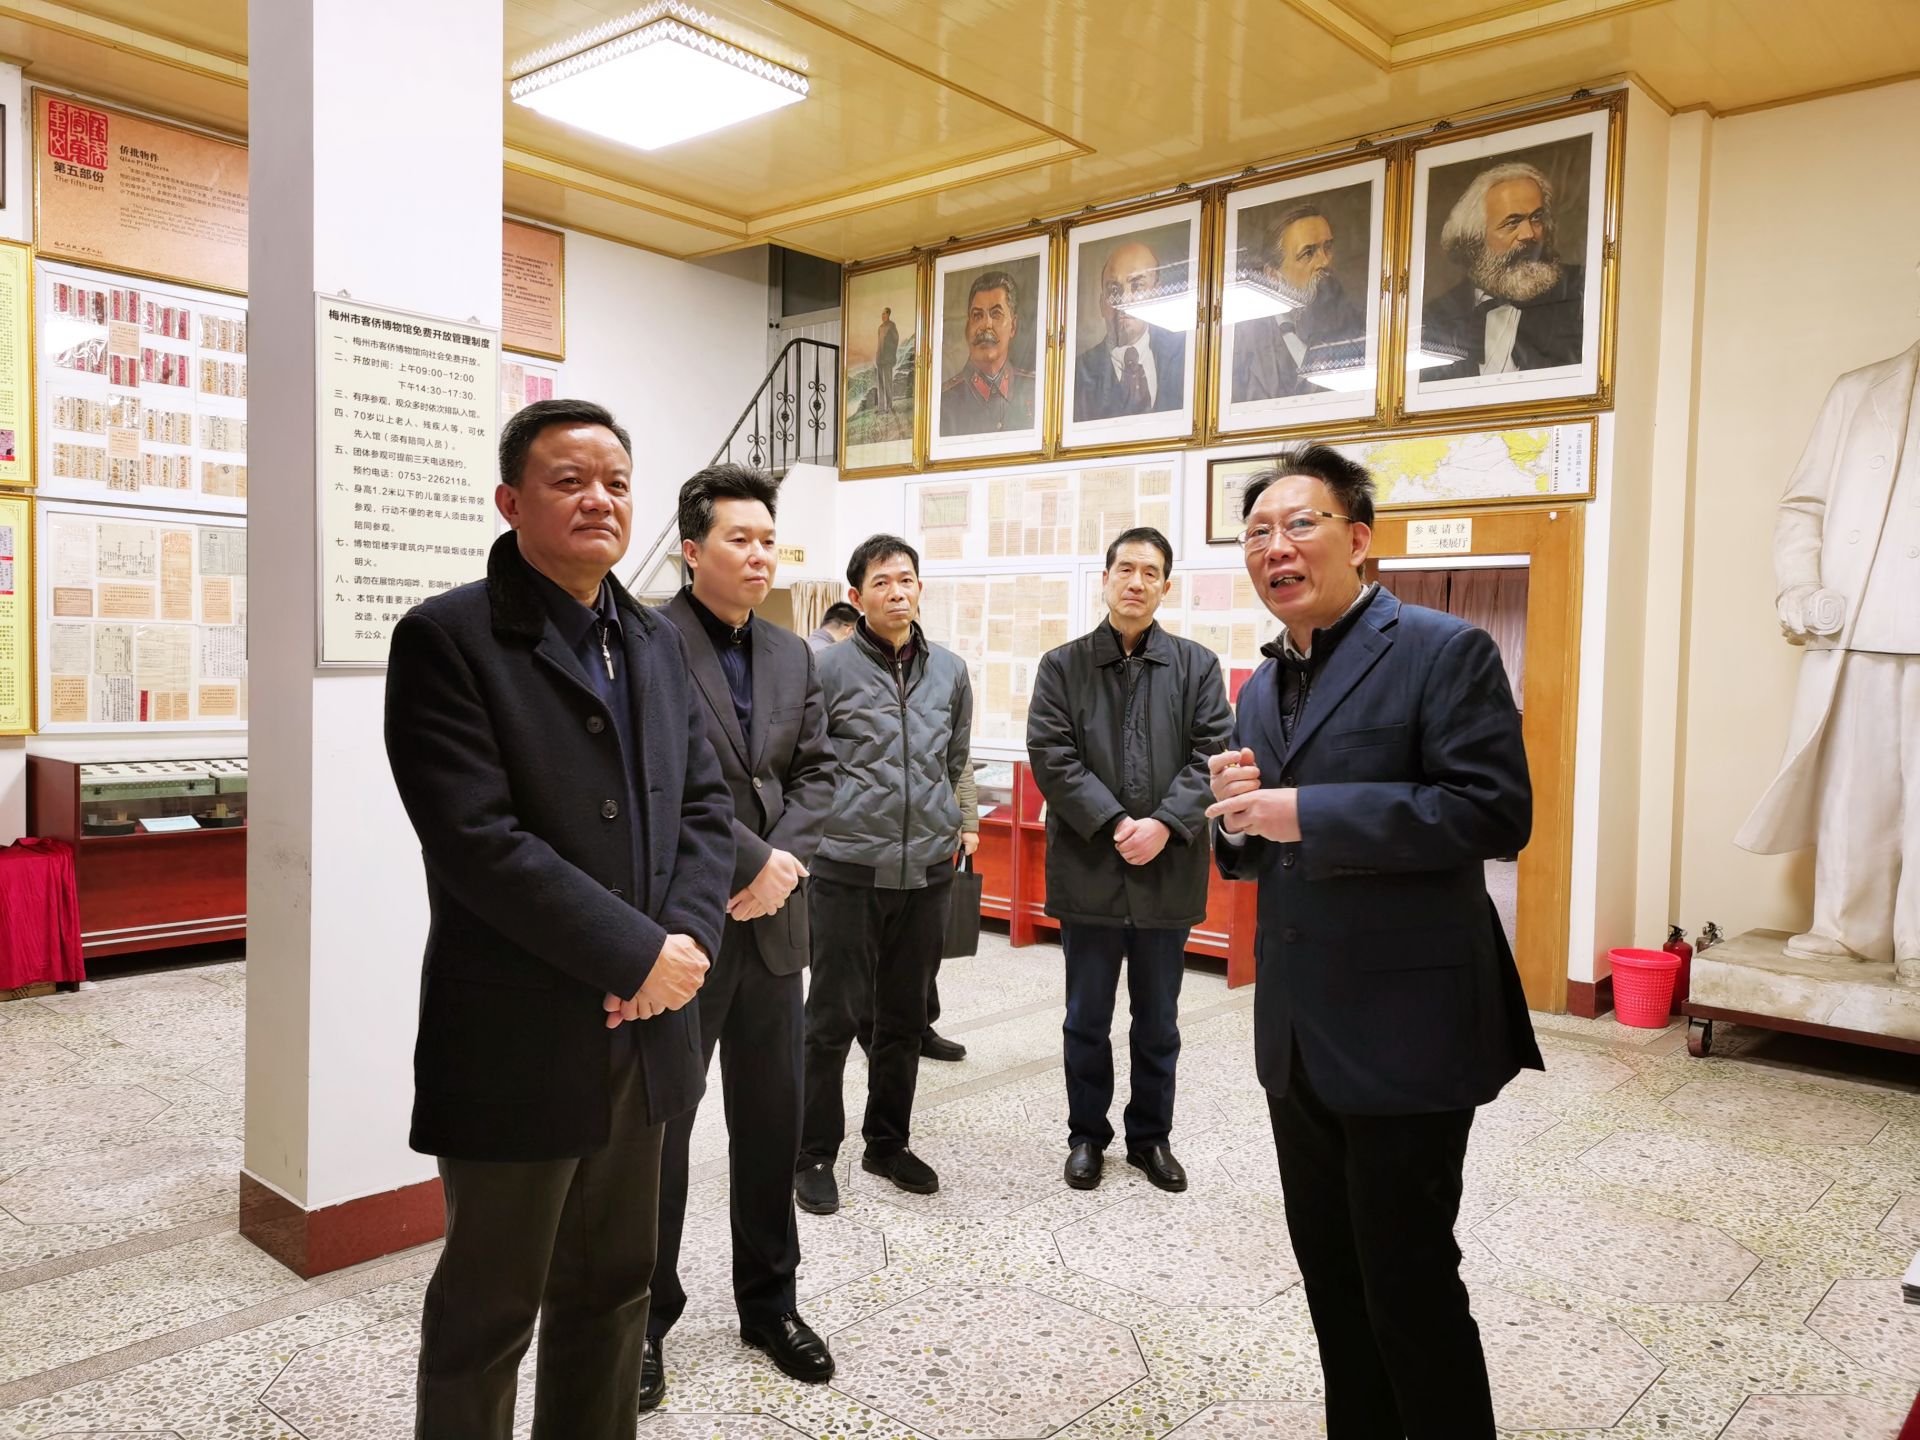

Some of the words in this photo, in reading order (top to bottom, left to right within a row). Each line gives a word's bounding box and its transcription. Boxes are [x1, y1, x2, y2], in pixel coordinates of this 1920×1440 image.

[54, 161, 104, 183] 第五部份
[54, 174, 69, 183] The
[70, 178, 87, 188] fifth
[88, 184, 104, 192] part
[328, 309, 491, 349] 梅州市客侨博物馆免费开放管理制度
[354, 612, 406, 622] 改造、保养
